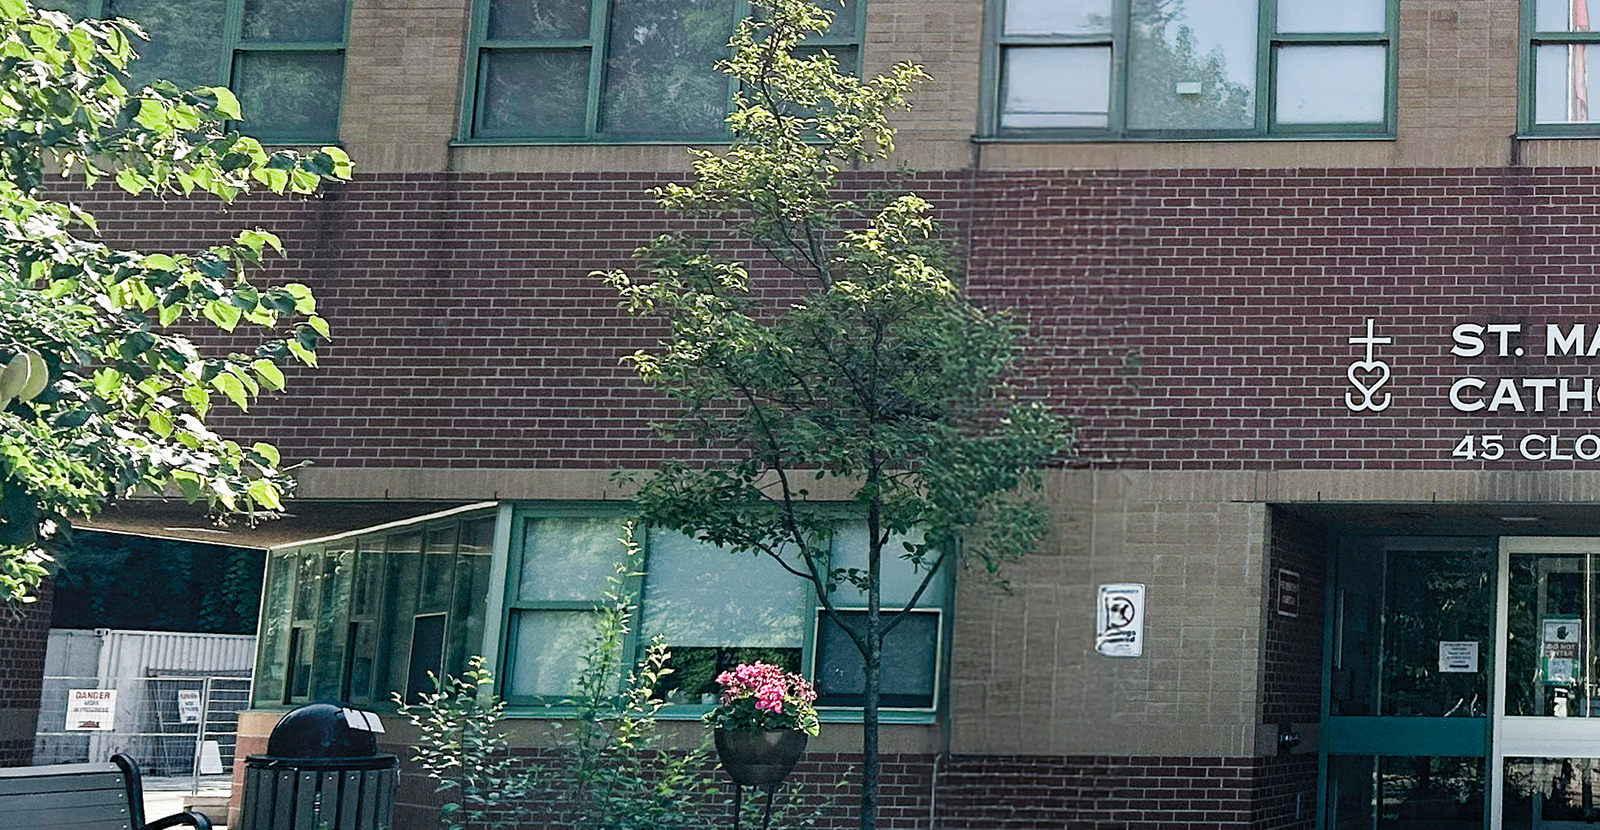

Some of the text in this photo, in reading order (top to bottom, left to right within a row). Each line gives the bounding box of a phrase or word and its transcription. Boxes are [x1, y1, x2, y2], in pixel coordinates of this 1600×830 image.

[1450, 323, 1525, 357] ST.
[1452, 434, 1504, 461] 45
[76, 691, 111, 699] DANGER
